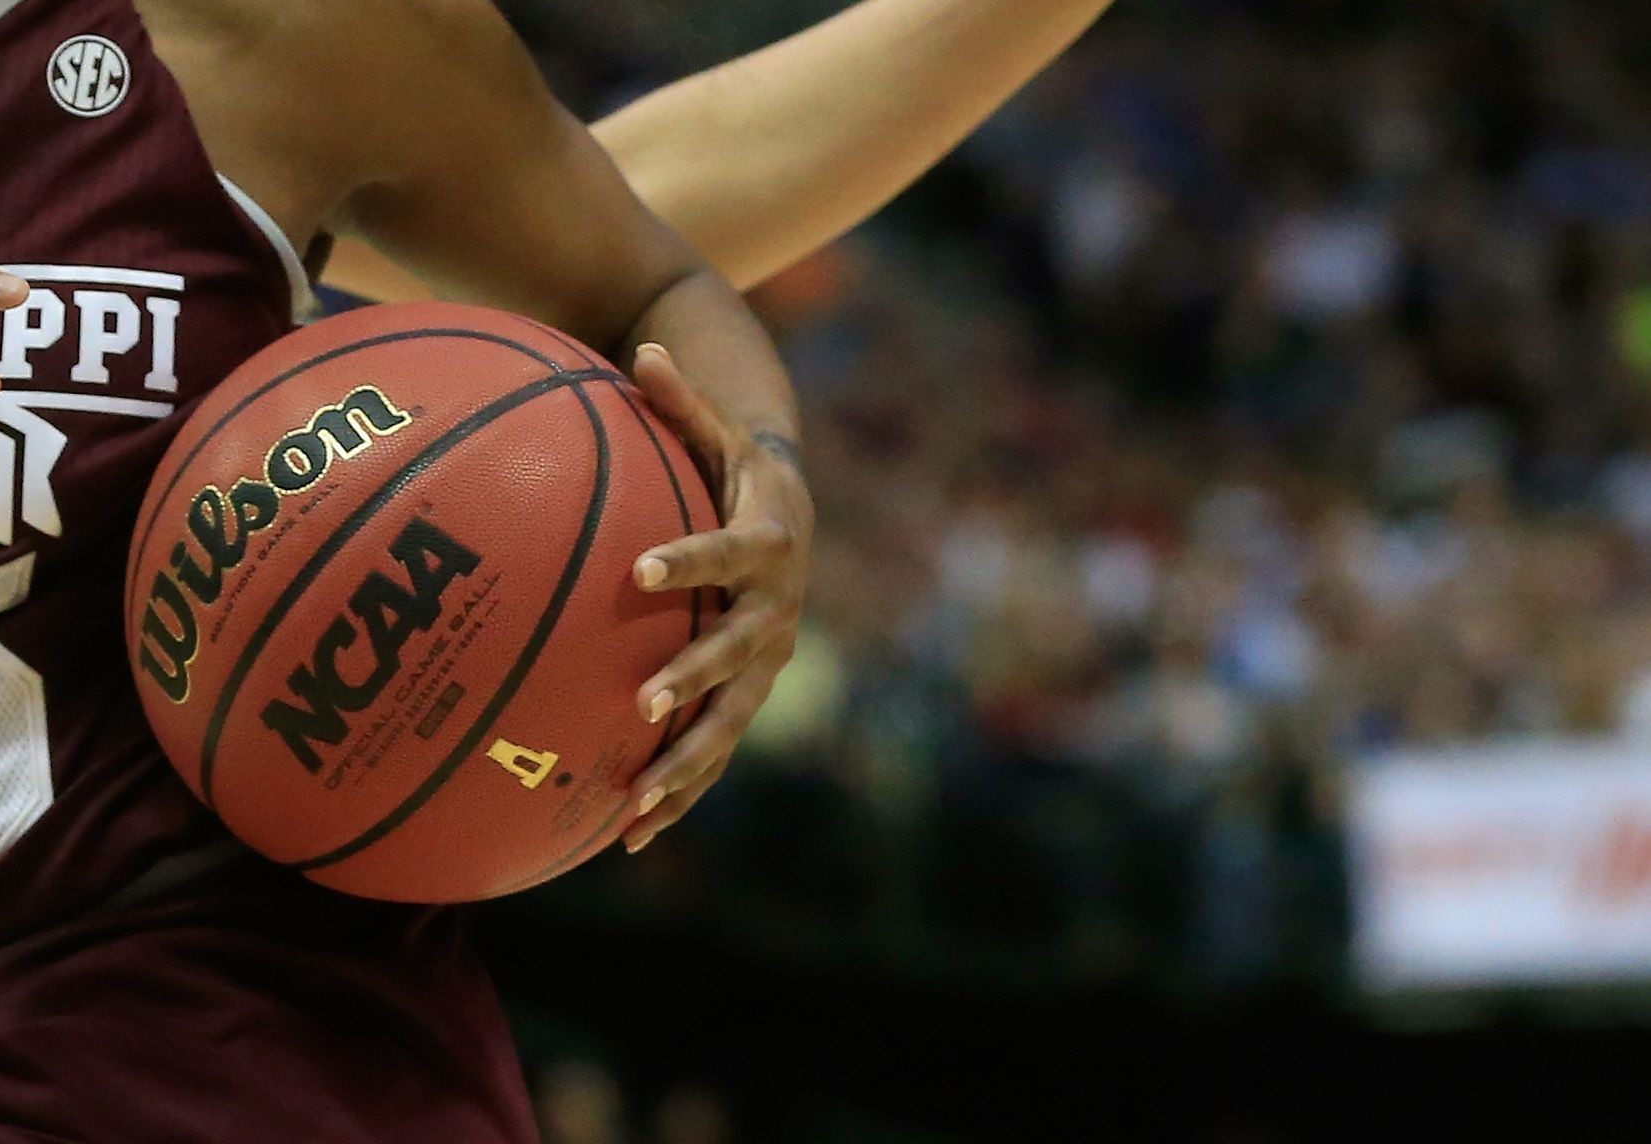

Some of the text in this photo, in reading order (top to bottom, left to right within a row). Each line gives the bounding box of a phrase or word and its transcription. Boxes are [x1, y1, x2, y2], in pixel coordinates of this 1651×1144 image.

[53, 40, 125, 111] SEC
[139, 384, 414, 705] Wilson
[259, 514, 485, 775] NCAA
